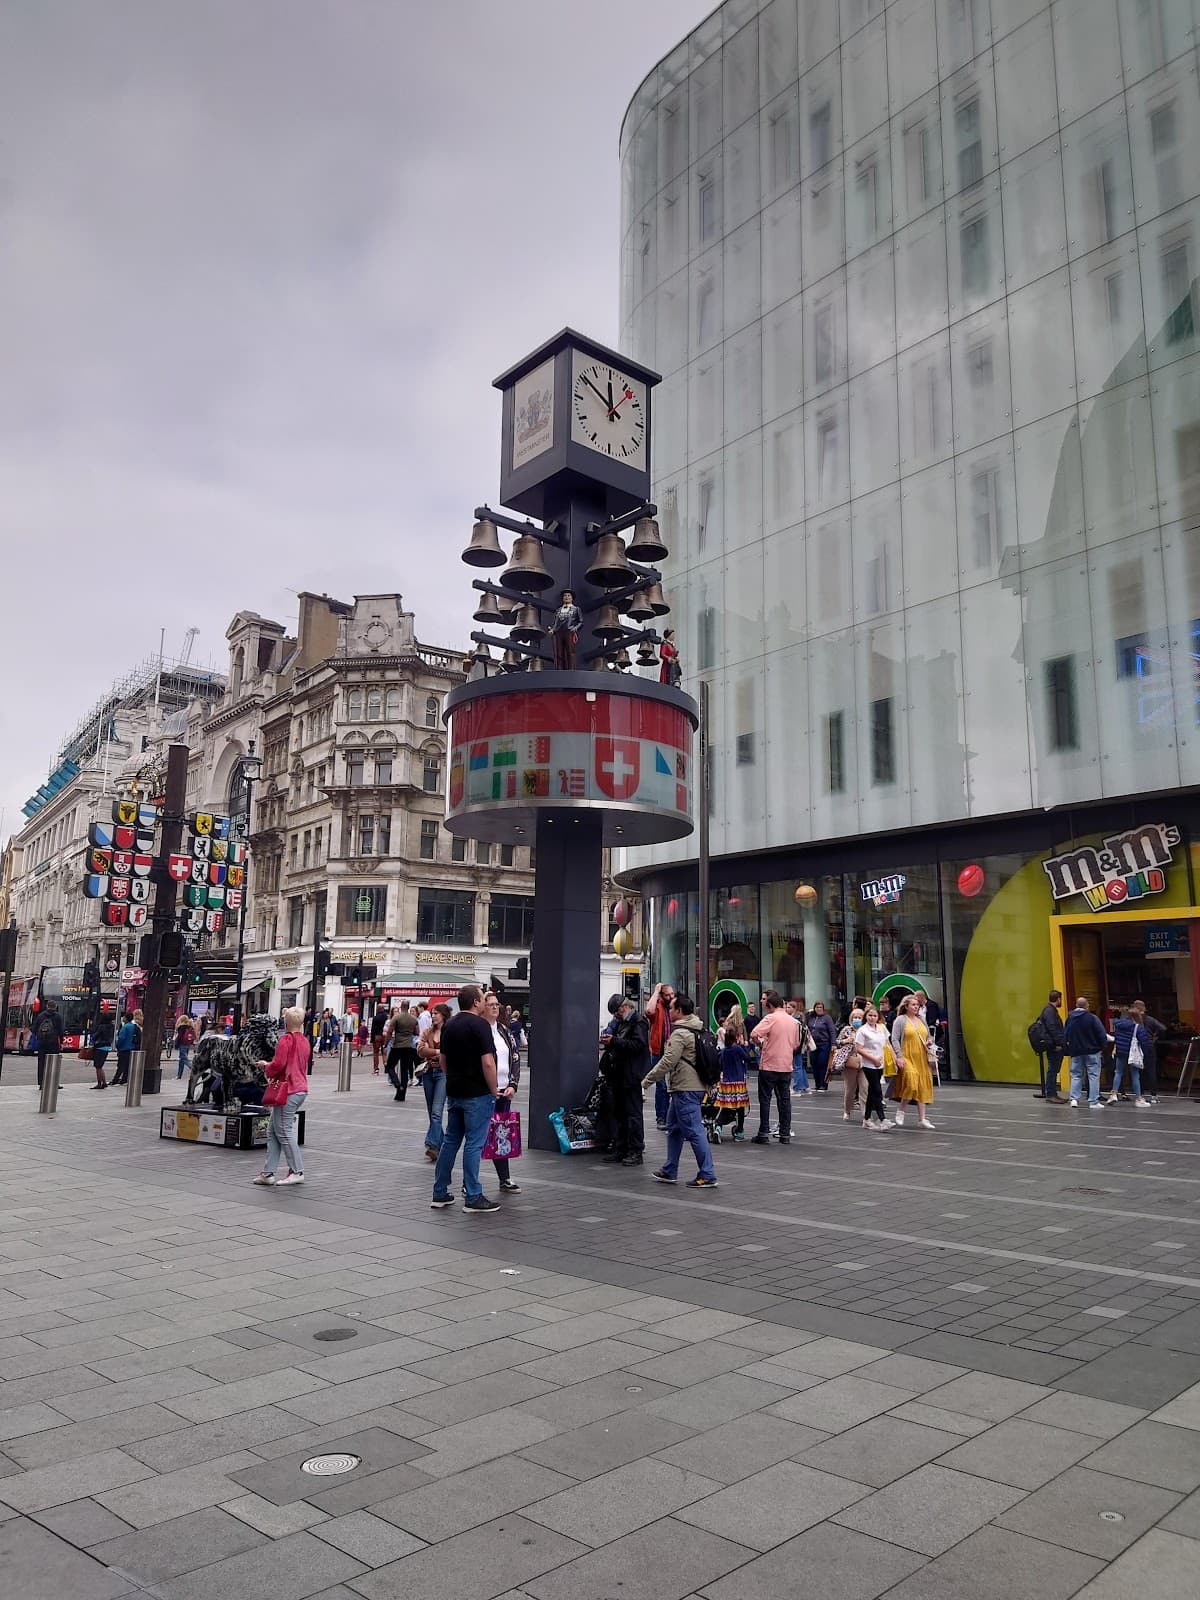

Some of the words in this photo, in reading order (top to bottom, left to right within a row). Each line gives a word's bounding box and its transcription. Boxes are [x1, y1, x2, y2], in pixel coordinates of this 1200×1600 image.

[1150, 931, 1169, 940] EXIT
[1149, 940, 1171, 948] ONLY
[416, 952, 445, 963] SHAKE
[447, 953, 477, 964] SHACK
